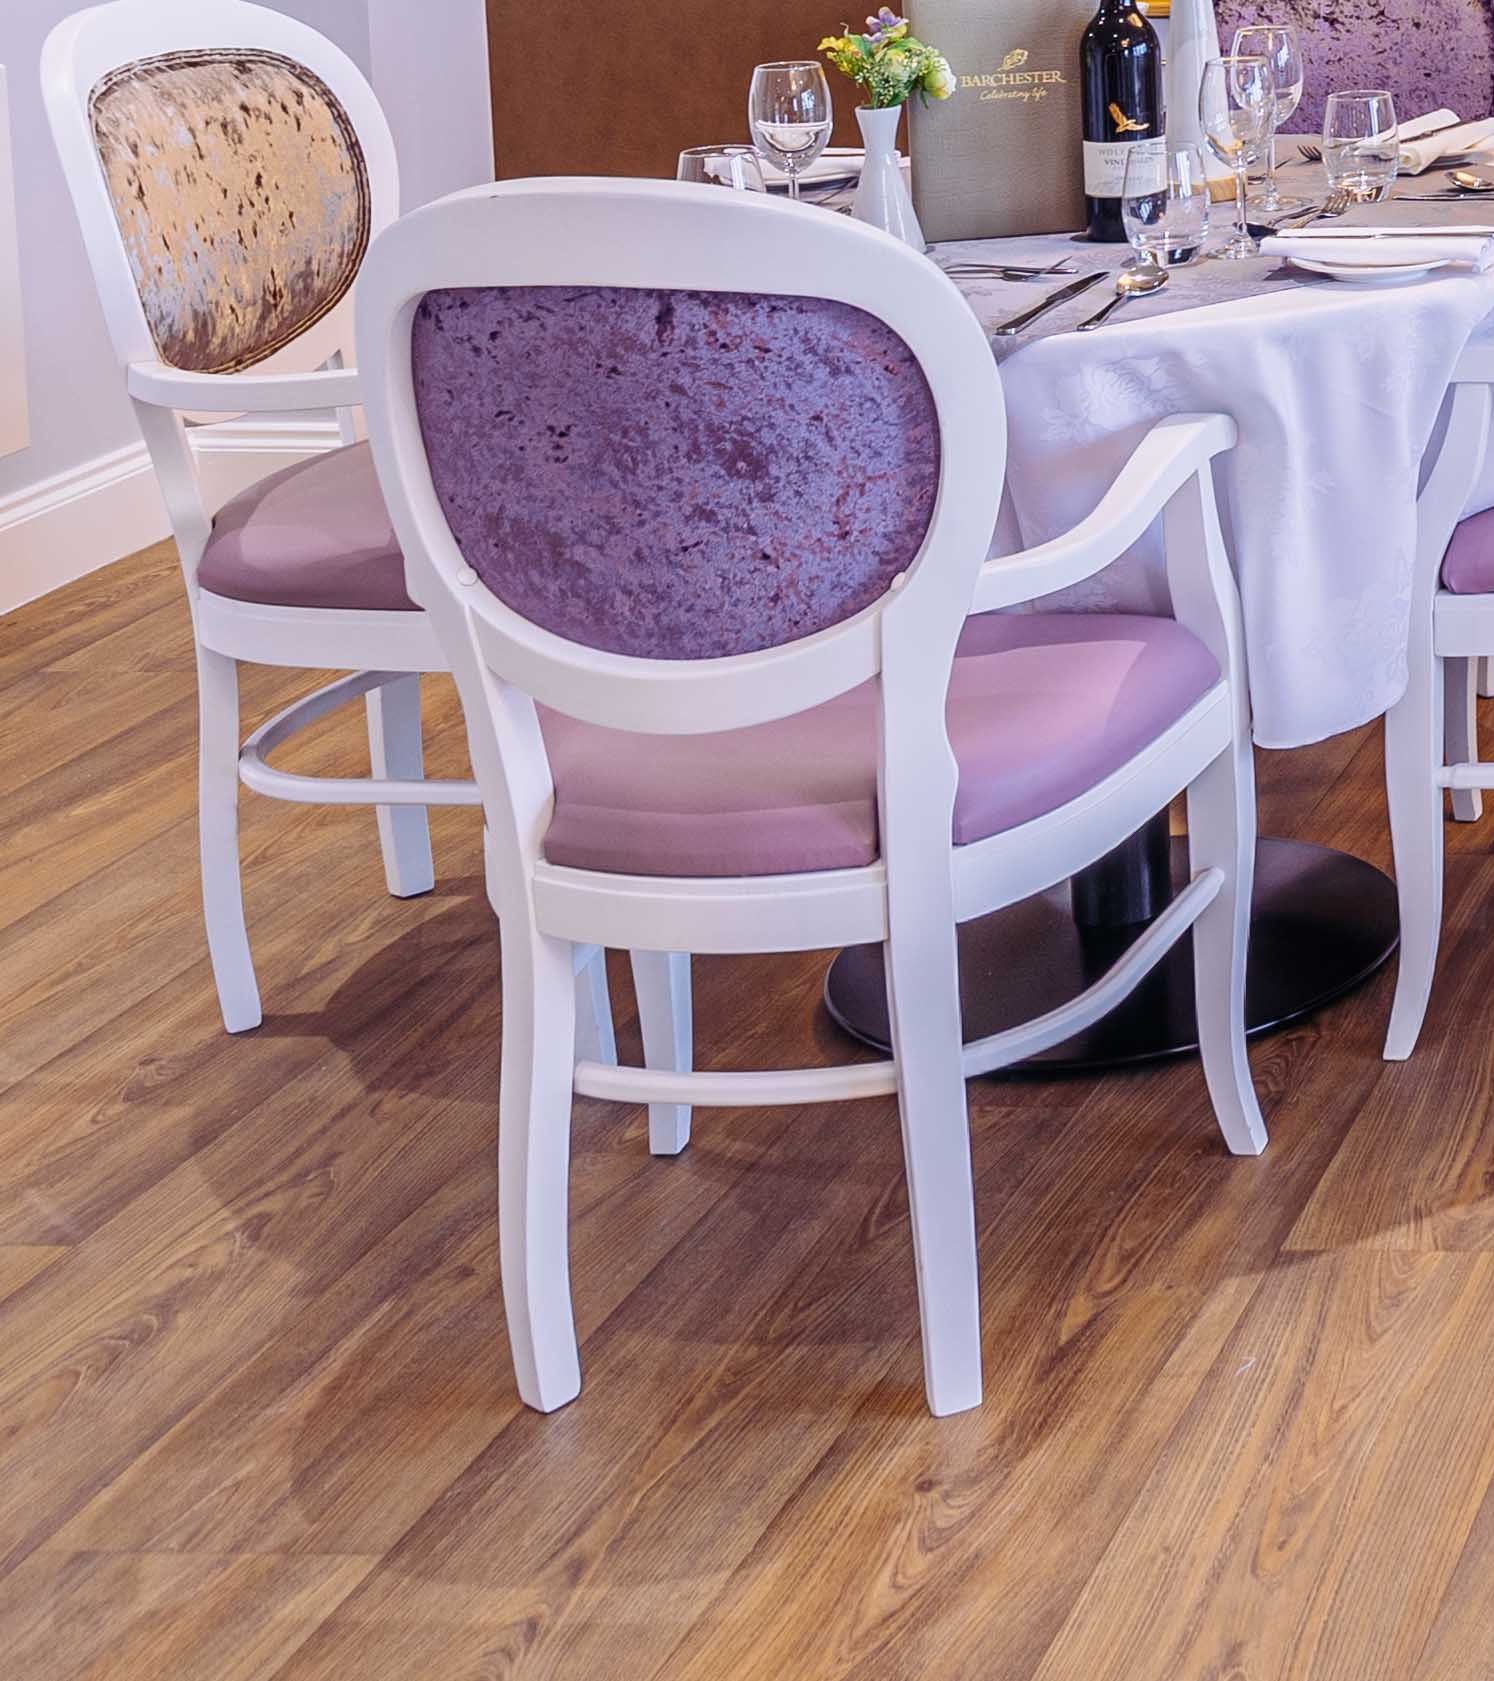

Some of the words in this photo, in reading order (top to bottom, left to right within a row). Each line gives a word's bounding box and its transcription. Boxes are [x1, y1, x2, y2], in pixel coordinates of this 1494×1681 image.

[961, 70, 1067, 88] BARCHESTER
[979, 88, 1029, 102] Celebrating
[1030, 86, 1048, 101] life
